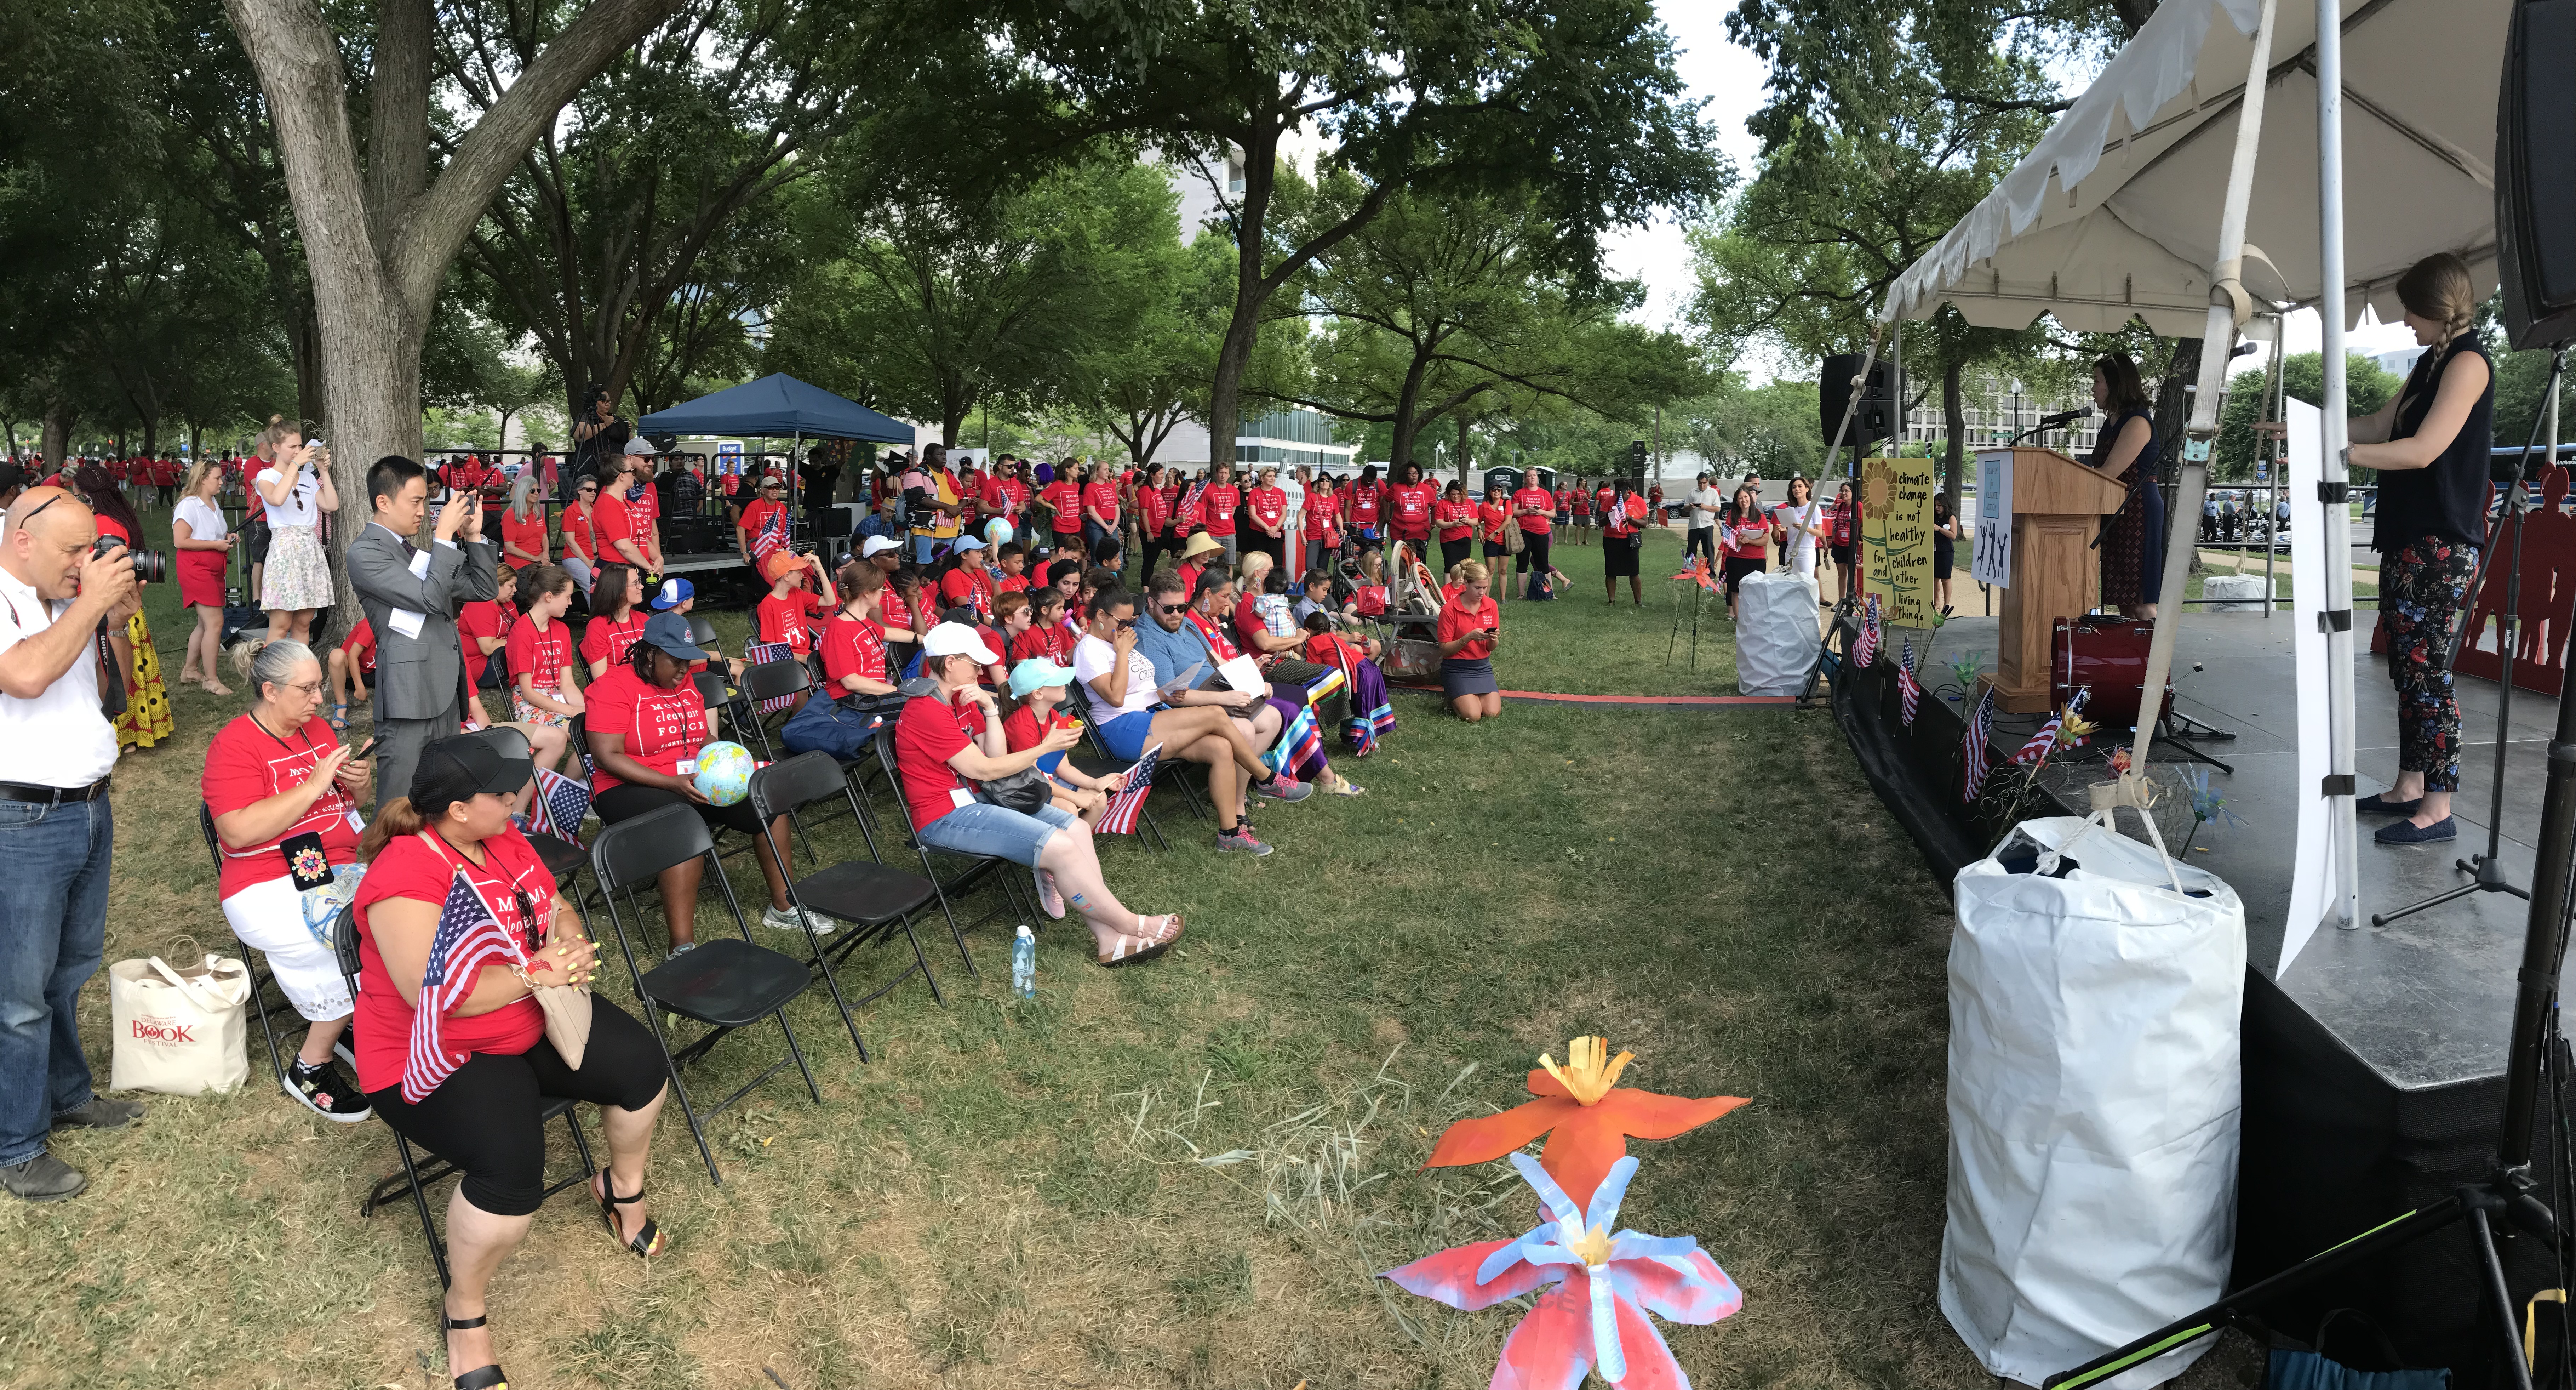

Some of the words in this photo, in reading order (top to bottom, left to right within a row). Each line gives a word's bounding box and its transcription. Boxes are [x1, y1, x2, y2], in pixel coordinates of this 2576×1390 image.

[1899, 472, 1929, 486] climate
[1899, 486, 1927, 508] change
[1896, 510, 1903, 521] is
[1907, 509, 1921, 523] not
[1890, 525, 1926, 546] healthy
[1874, 549, 1885, 564] for
[1892, 553, 1927, 569] children
[1873, 565, 1888, 577] and
[1895, 570, 1918, 585] other
[1899, 593, 1921, 614] living
[1898, 606, 1924, 627] things
[619, 636, 643, 645] MOMS
[650, 698, 691, 711] MOMS
[656, 710, 683, 723] clean
[688, 708, 699, 719] air
[658, 721, 704, 737] FORCE
[660, 738, 690, 749] FIGHTING
[141, 1017, 176, 1026] DELAWARE
[131, 1020, 196, 1042] BOOK
[144, 1038, 179, 1047] FESTIVAL
